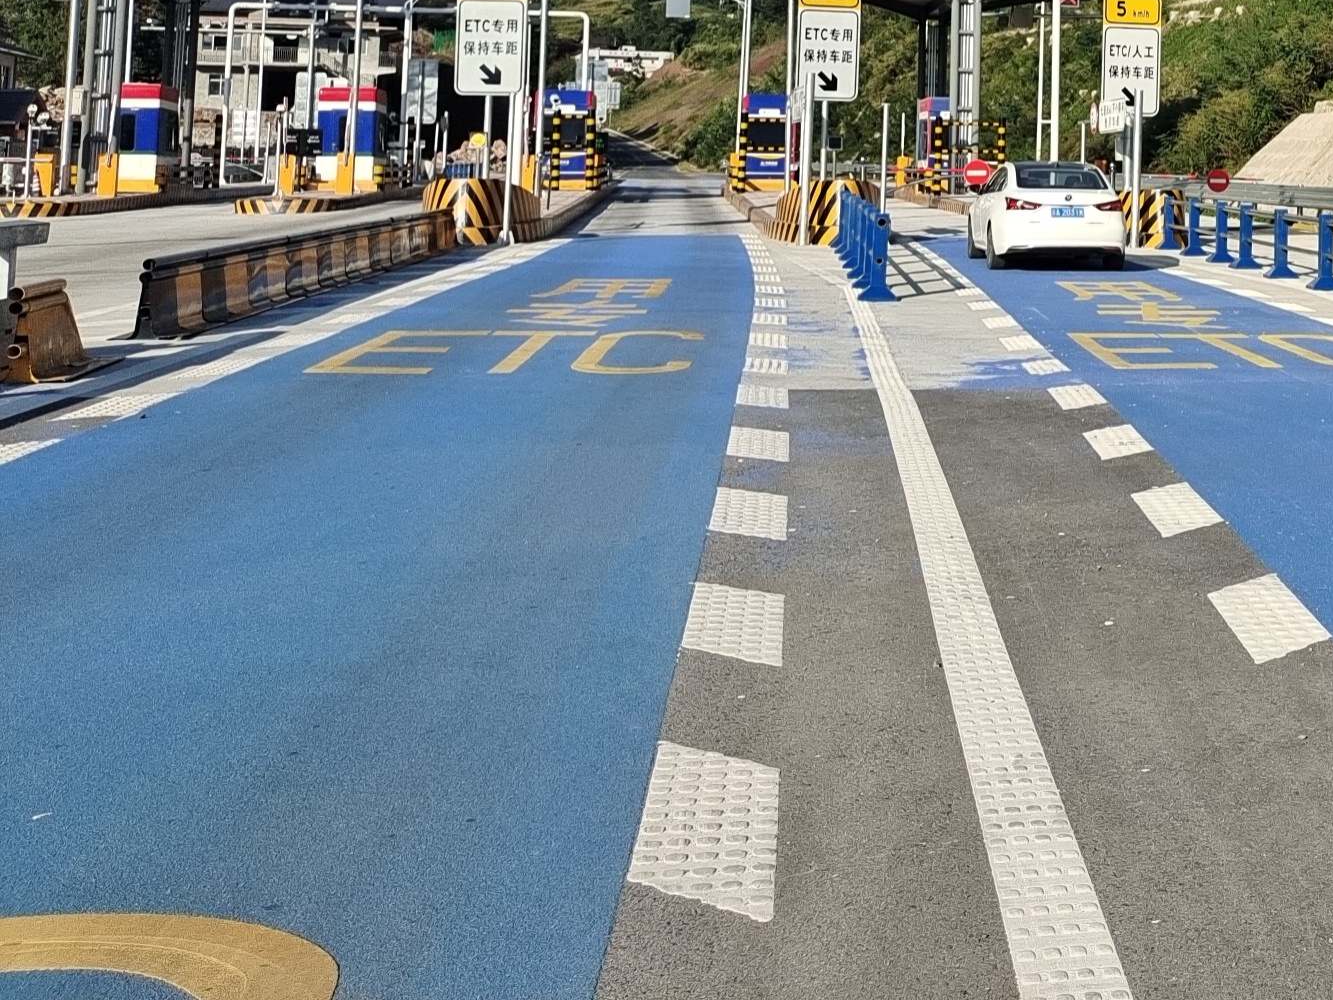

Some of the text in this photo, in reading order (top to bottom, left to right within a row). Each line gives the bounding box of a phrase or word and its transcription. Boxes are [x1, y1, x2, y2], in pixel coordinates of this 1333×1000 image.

[1116, 0, 1150, 18] 5 km/h
[464, 19, 518, 34] ETC专用
[805, 28, 853, 42] ETC专用
[463, 41, 518, 56] 保持车距
[1109, 45, 1154, 58] ETC/人工
[804, 49, 853, 64] 保持车距
[1109, 65, 1154, 80] 保持车距
[302, 330, 706, 375] ETC
